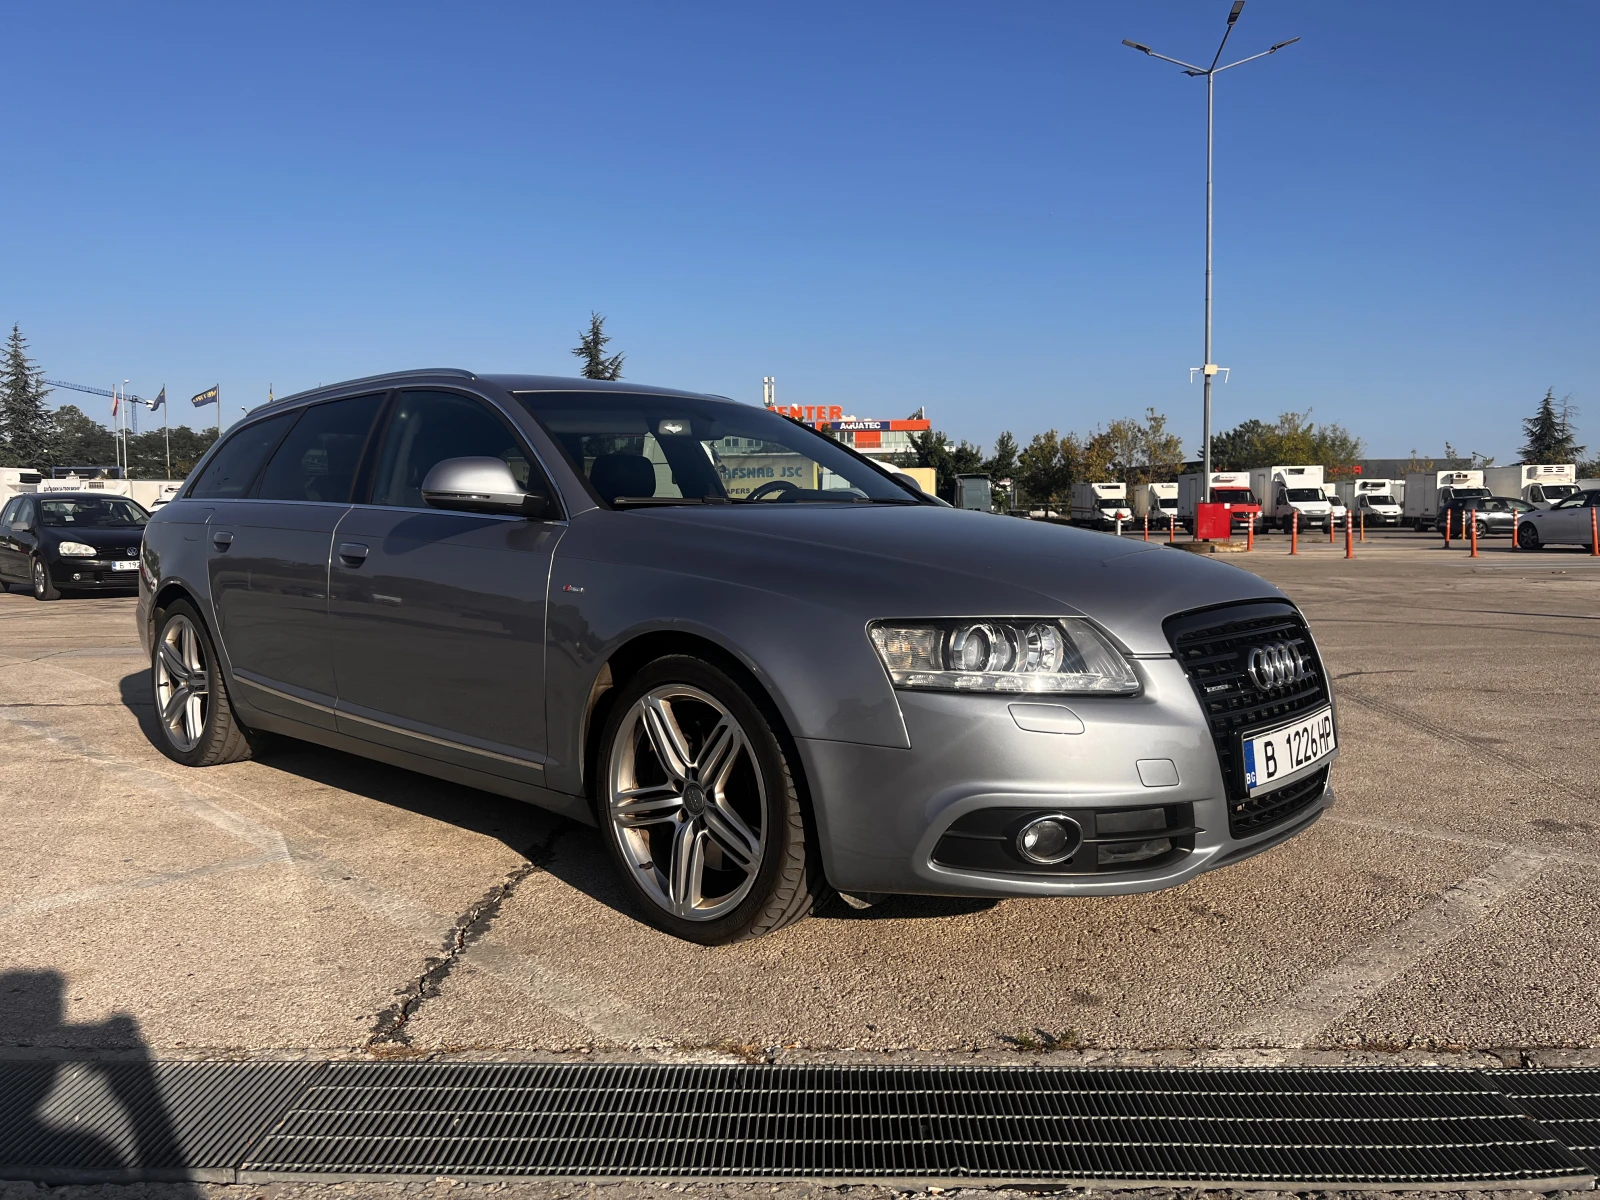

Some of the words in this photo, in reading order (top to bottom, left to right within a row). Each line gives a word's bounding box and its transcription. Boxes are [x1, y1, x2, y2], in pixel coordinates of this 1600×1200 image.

[720, 467, 774, 479] AFSNAB
[780, 467, 802, 478] JSC
[1264, 741, 1277, 778] B
[1246, 772, 1256, 784] BG
